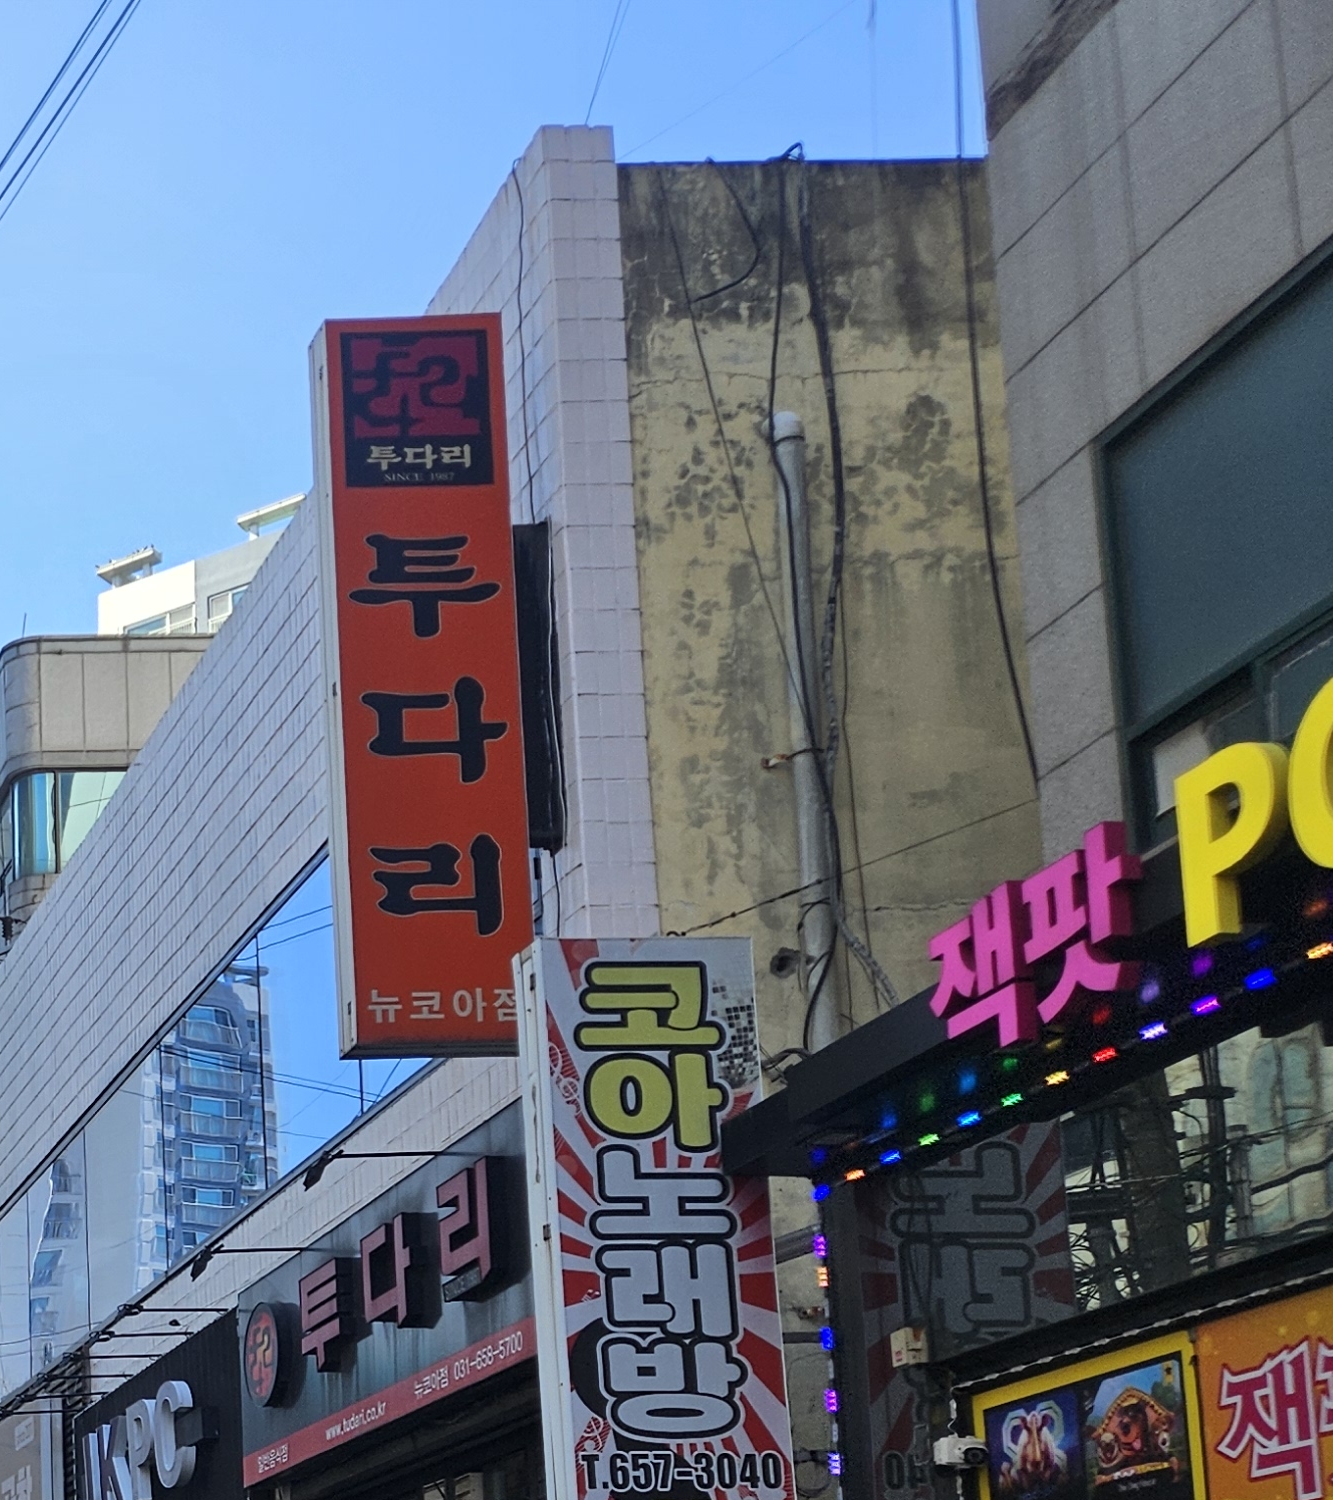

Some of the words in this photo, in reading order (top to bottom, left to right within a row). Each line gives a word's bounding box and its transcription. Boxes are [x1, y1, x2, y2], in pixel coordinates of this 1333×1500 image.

[367, 444, 471, 471] 투다리
[385, 472, 423, 482] SINCE
[431, 472, 454, 482] 1987
[349, 533, 507, 937] 투다리
[929, 821, 1141, 1047] 잭팟
[367, 988, 519, 1025] 뉴코아점
[299, 1155, 493, 1373] 투다리
[413, 1366, 449, 1399] 뉴코아점
[454, 1331, 523, 1380] 031-658-5700
[325, 1401, 386, 1440] www.tudari.co.kr
[257, 1444, 289, 1474] 일반음식점
[579, 1451, 783, 1493] T.657-3040
